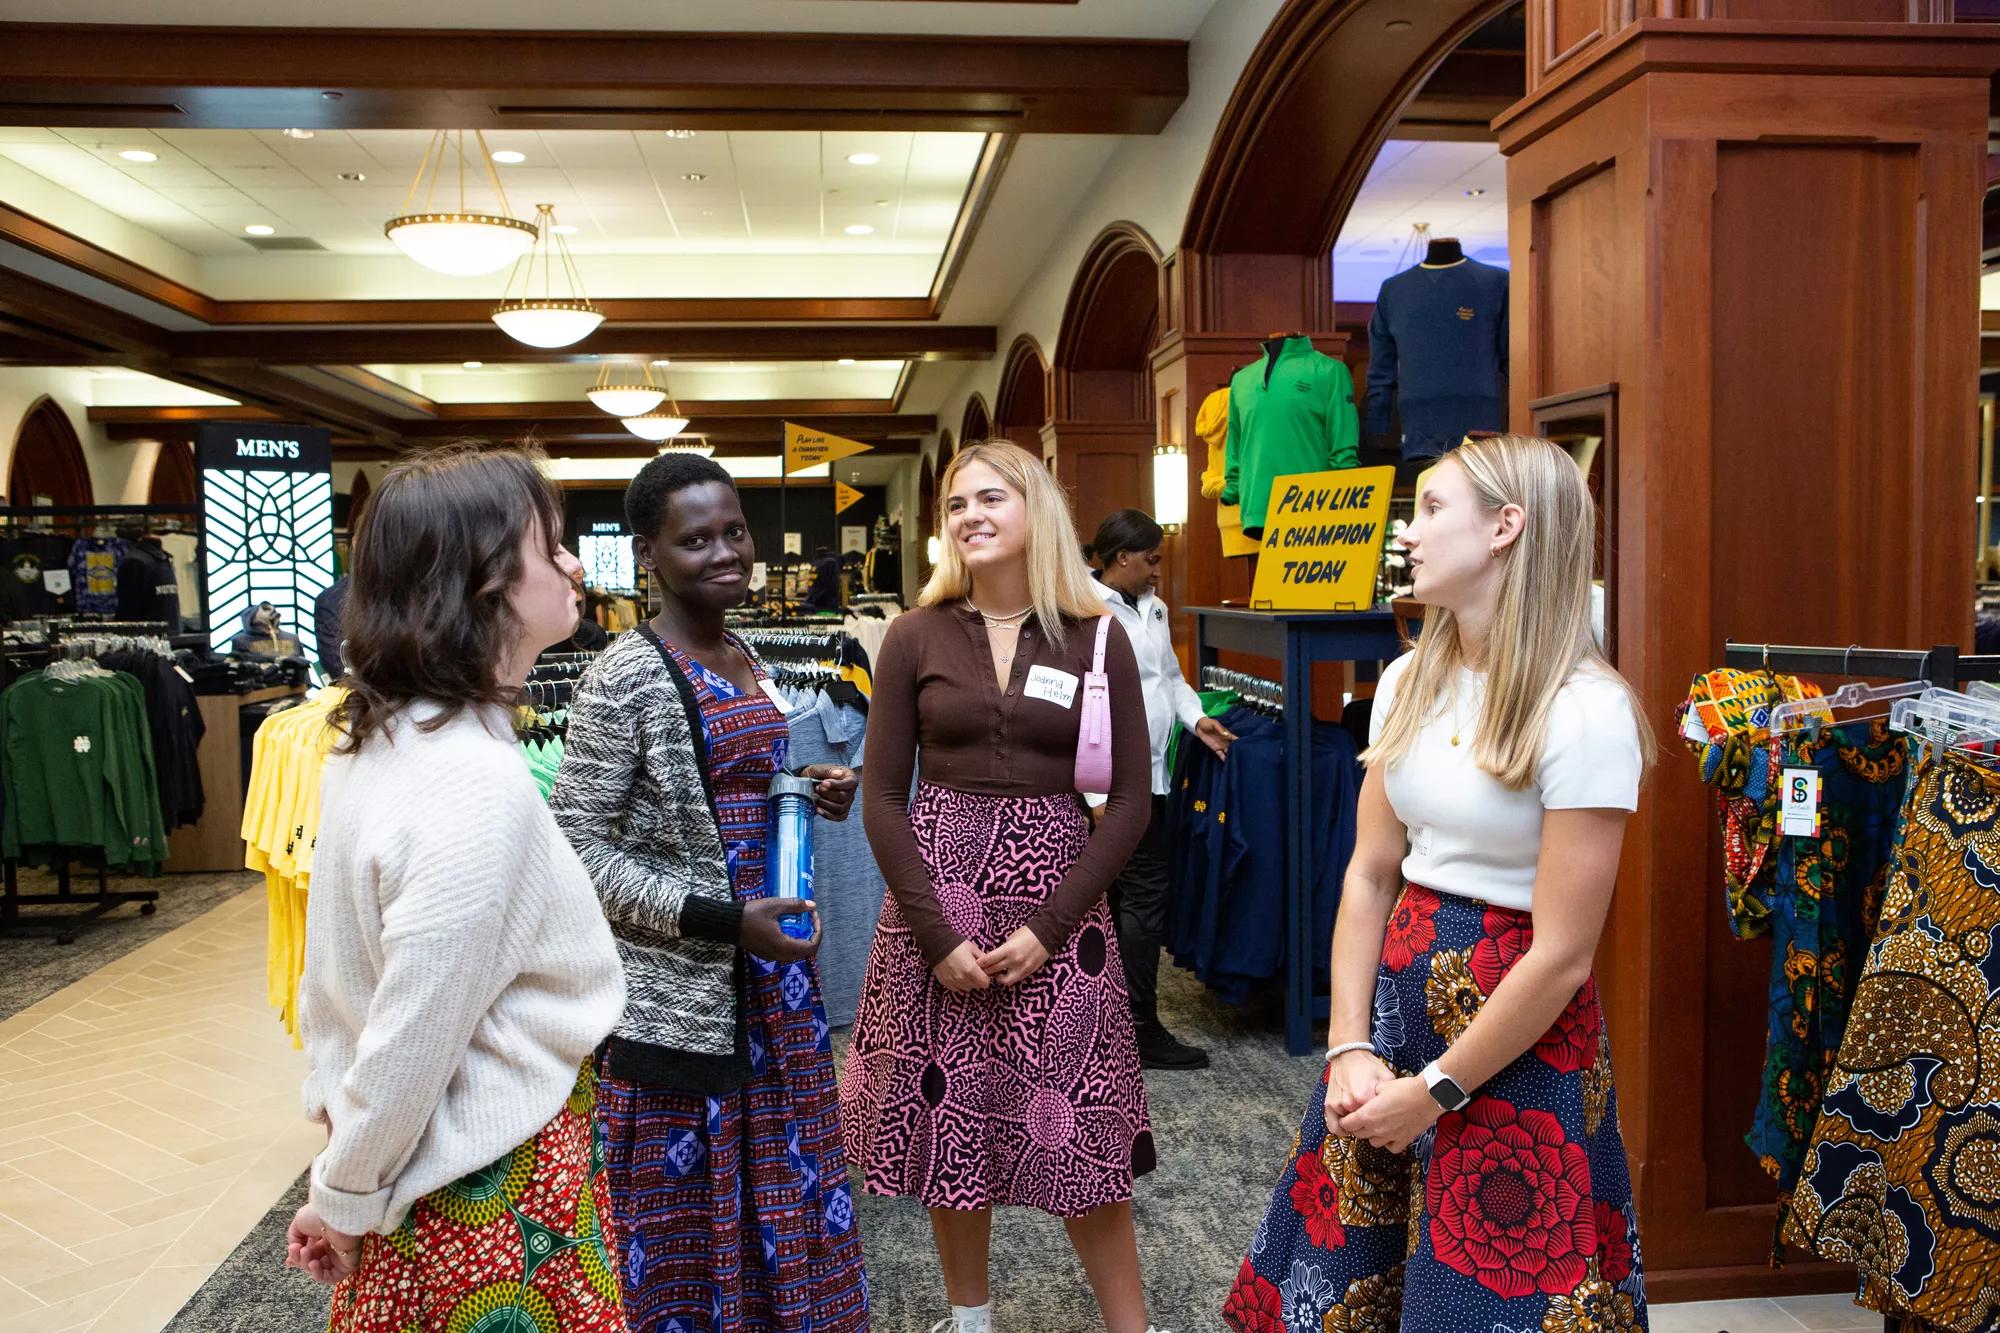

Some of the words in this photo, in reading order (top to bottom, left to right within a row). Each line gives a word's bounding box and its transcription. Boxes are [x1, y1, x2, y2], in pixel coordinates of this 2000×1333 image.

[1277, 485, 1331, 515] PLAY
[1328, 485, 1375, 511] LIKE
[1265, 527, 1280, 549] A
[1283, 522, 1377, 548] CHAMPION
[1282, 560, 1347, 585] TODAY
[1030, 672, 1064, 690] Joanna
